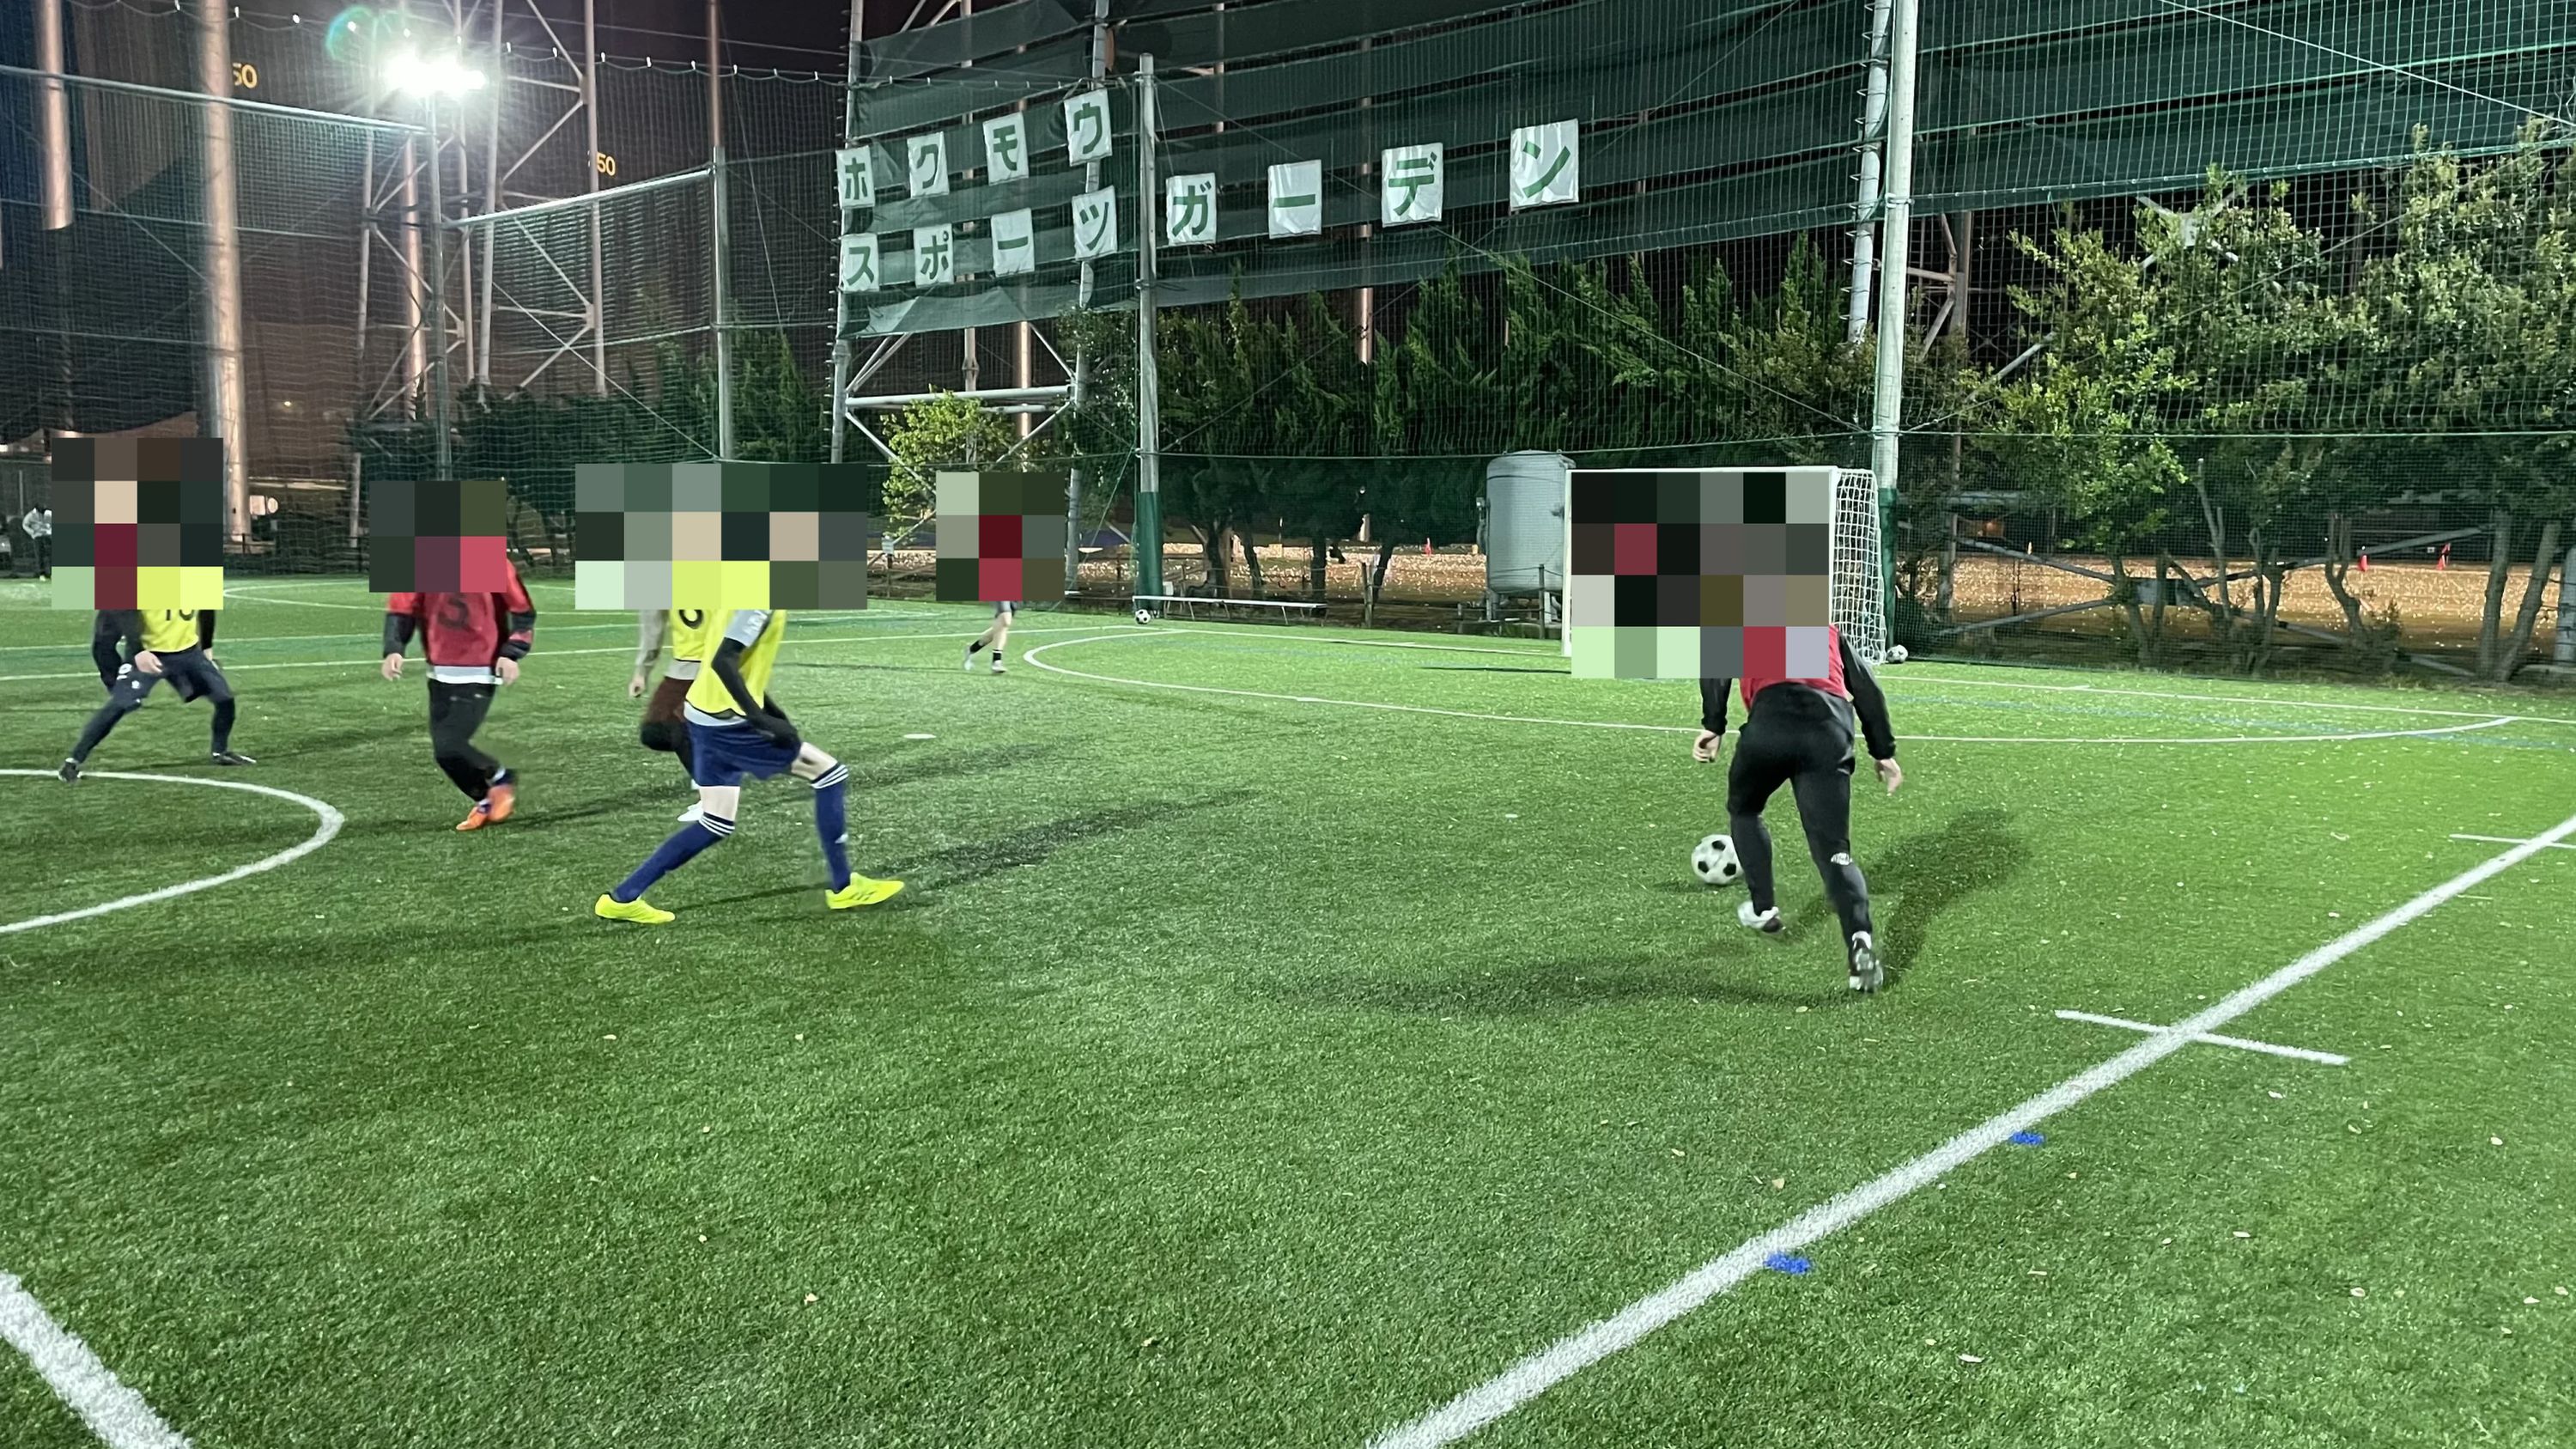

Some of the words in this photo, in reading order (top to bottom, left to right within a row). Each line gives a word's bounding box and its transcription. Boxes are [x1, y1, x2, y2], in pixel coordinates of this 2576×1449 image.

[587, 150, 616, 176] 50
[845, 102, 1102, 199] ホクモウ
